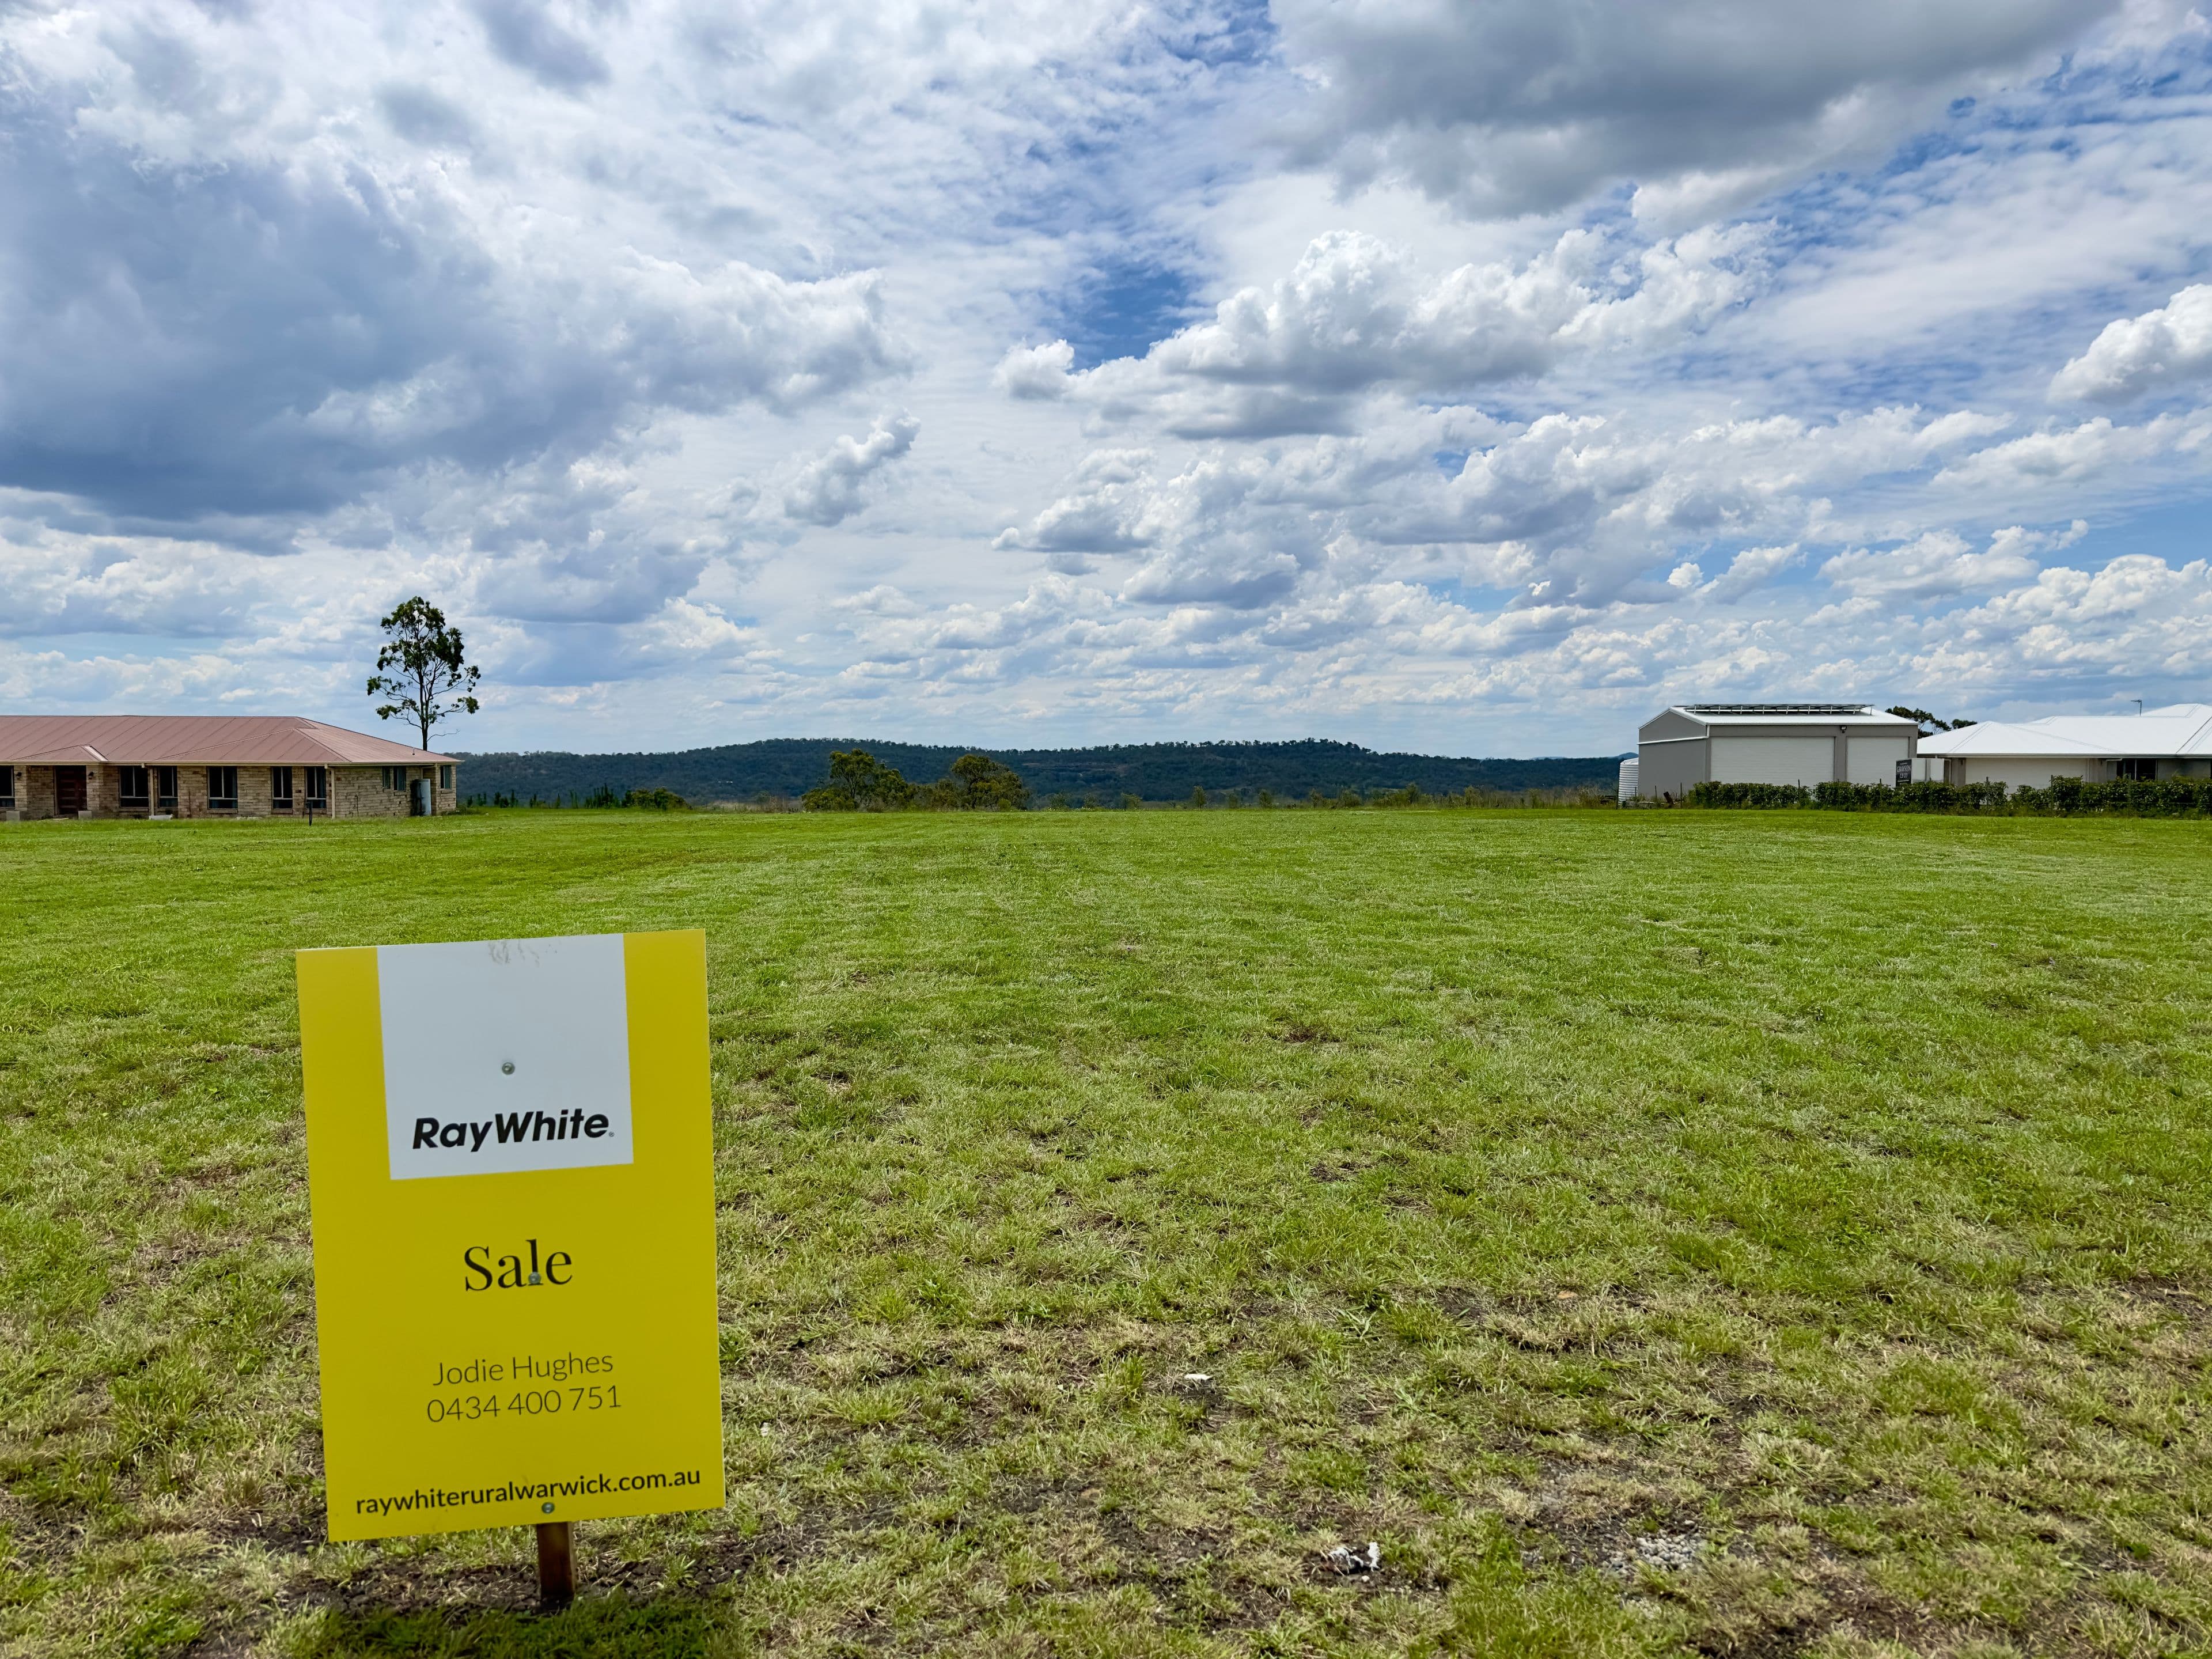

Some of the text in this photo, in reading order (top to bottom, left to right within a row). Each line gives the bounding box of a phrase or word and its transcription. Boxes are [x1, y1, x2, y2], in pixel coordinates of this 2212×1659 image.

[464, 1238, 572, 1291] Sale
[433, 1351, 613, 1386] Jodie Hughes
[427, 1385, 622, 1423] 0434 400 751
[356, 1470, 700, 1517] raywhiteruralwarwick.com.au
